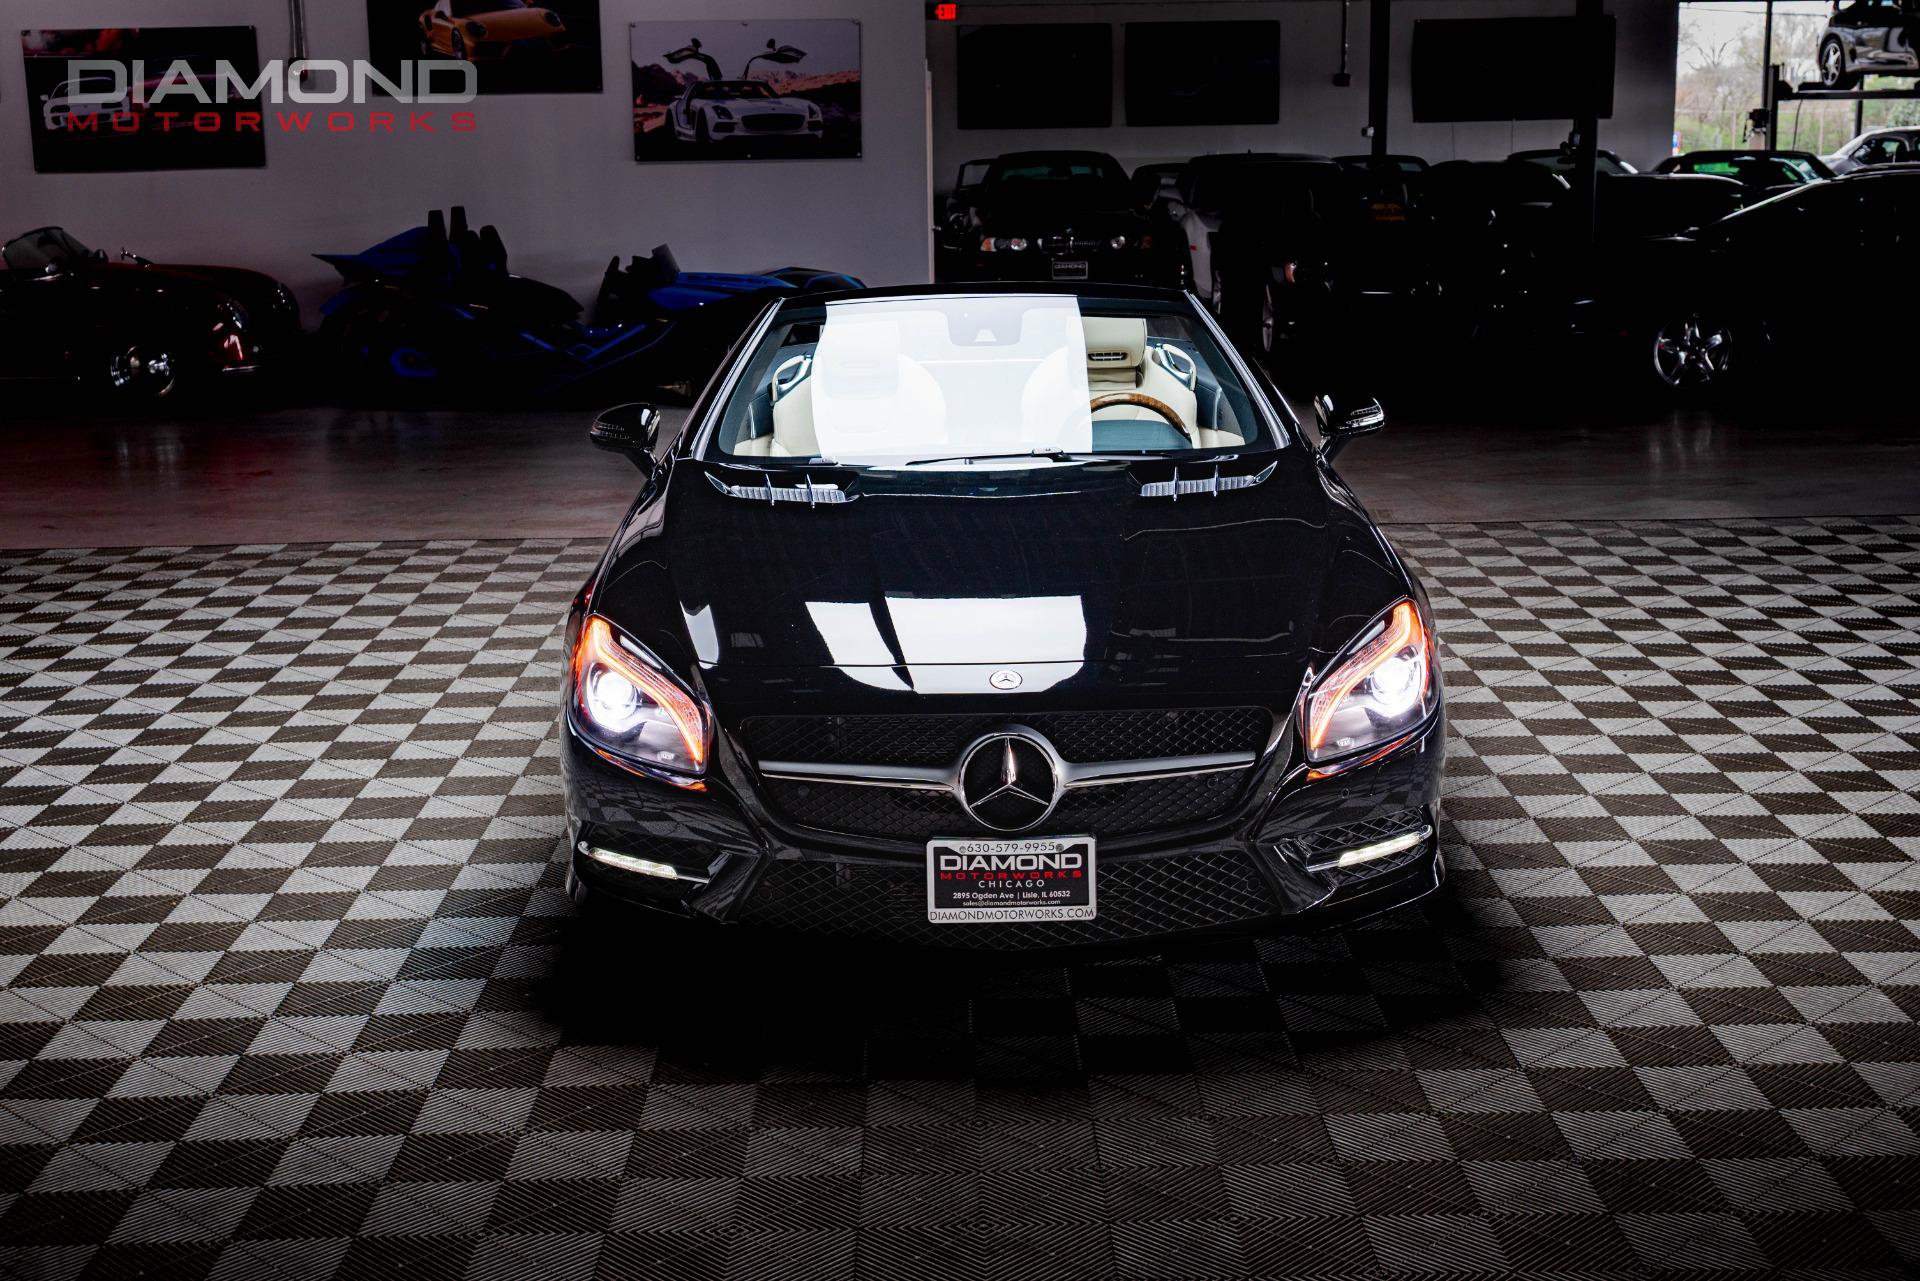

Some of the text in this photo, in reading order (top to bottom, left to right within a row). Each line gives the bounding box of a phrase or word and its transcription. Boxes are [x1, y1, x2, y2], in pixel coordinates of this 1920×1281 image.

[967, 841, 1055, 853] 630-579-9955
[939, 853, 1083, 871] DIAMOND
[939, 870, 1083, 881] MOTORWORKS
[978, 879, 1045, 888] CHICAGO
[971, 892, 998, 900] Ogden
[1049, 890, 1071, 898] 60532
[962, 899, 1061, 907] sales@diamondmotorworks.com
[929, 908, 1094, 921] DIAMONDMOTORWORKS.COM
